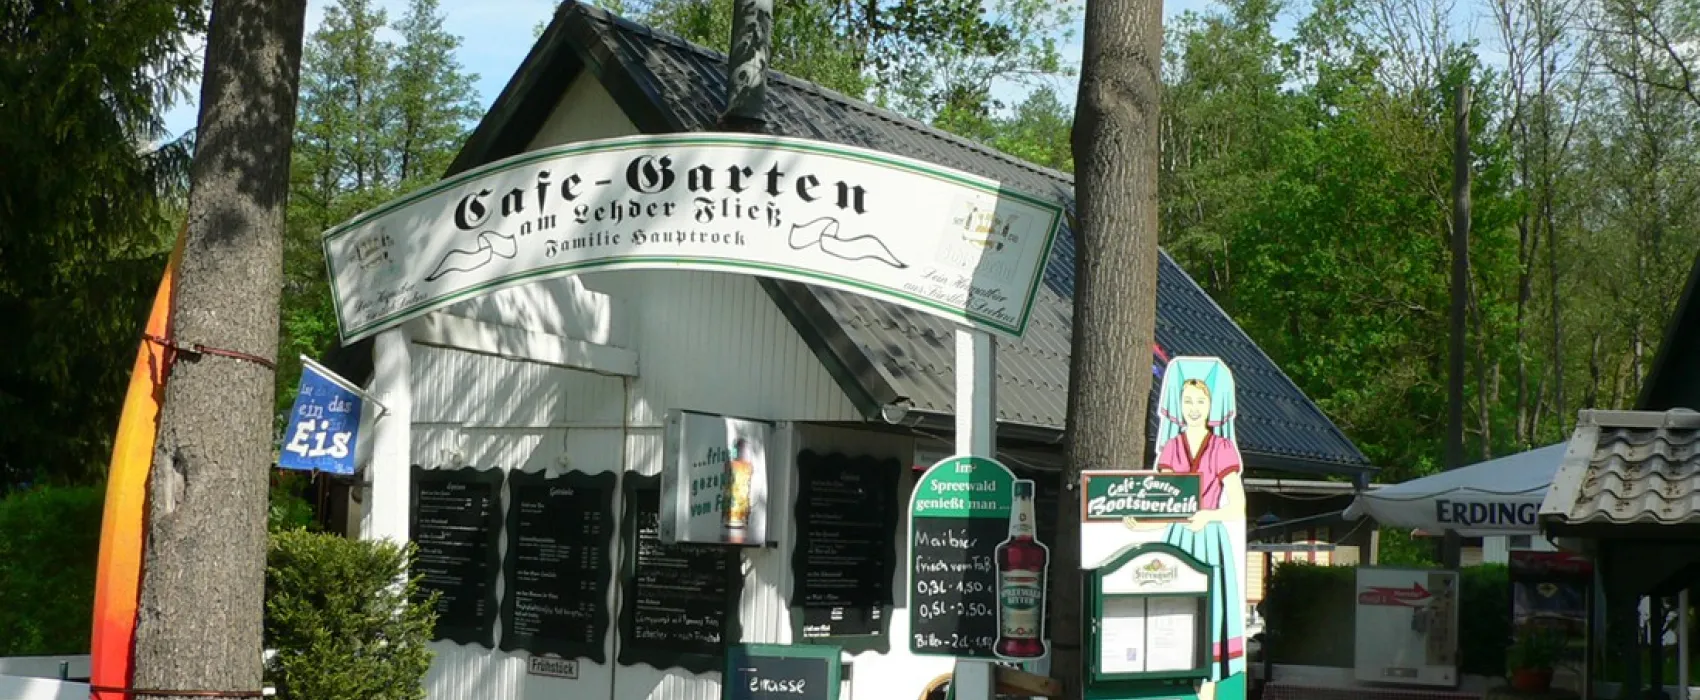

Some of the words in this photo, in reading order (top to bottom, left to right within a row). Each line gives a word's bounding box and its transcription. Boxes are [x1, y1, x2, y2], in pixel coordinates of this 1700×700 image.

[520, 213, 557, 236] am
[574, 199, 676, 225] Lehder
[694, 197, 782, 228] Fließ
[545, 230, 621, 258] Familie
[632, 228, 746, 246] Hauptrock
[298, 399, 324, 420] ein
[328, 394, 353, 413] das
[286, 418, 352, 459] Eis
[954, 461, 973, 474] Im
[930, 479, 996, 494] Spreewald
[1137, 488, 1148, 499] &
[915, 497, 964, 511] genießt
[968, 501, 996, 510] man
[1087, 495, 1198, 516] Bootsverleih
[1435, 500, 1541, 527] ERDING
[914, 528, 978, 549] Maibier
[915, 554, 949, 574] frisch
[949, 562, 973, 573] vom
[532, 657, 574, 675] Frühstück
[738, 667, 807, 694] Terrasse
